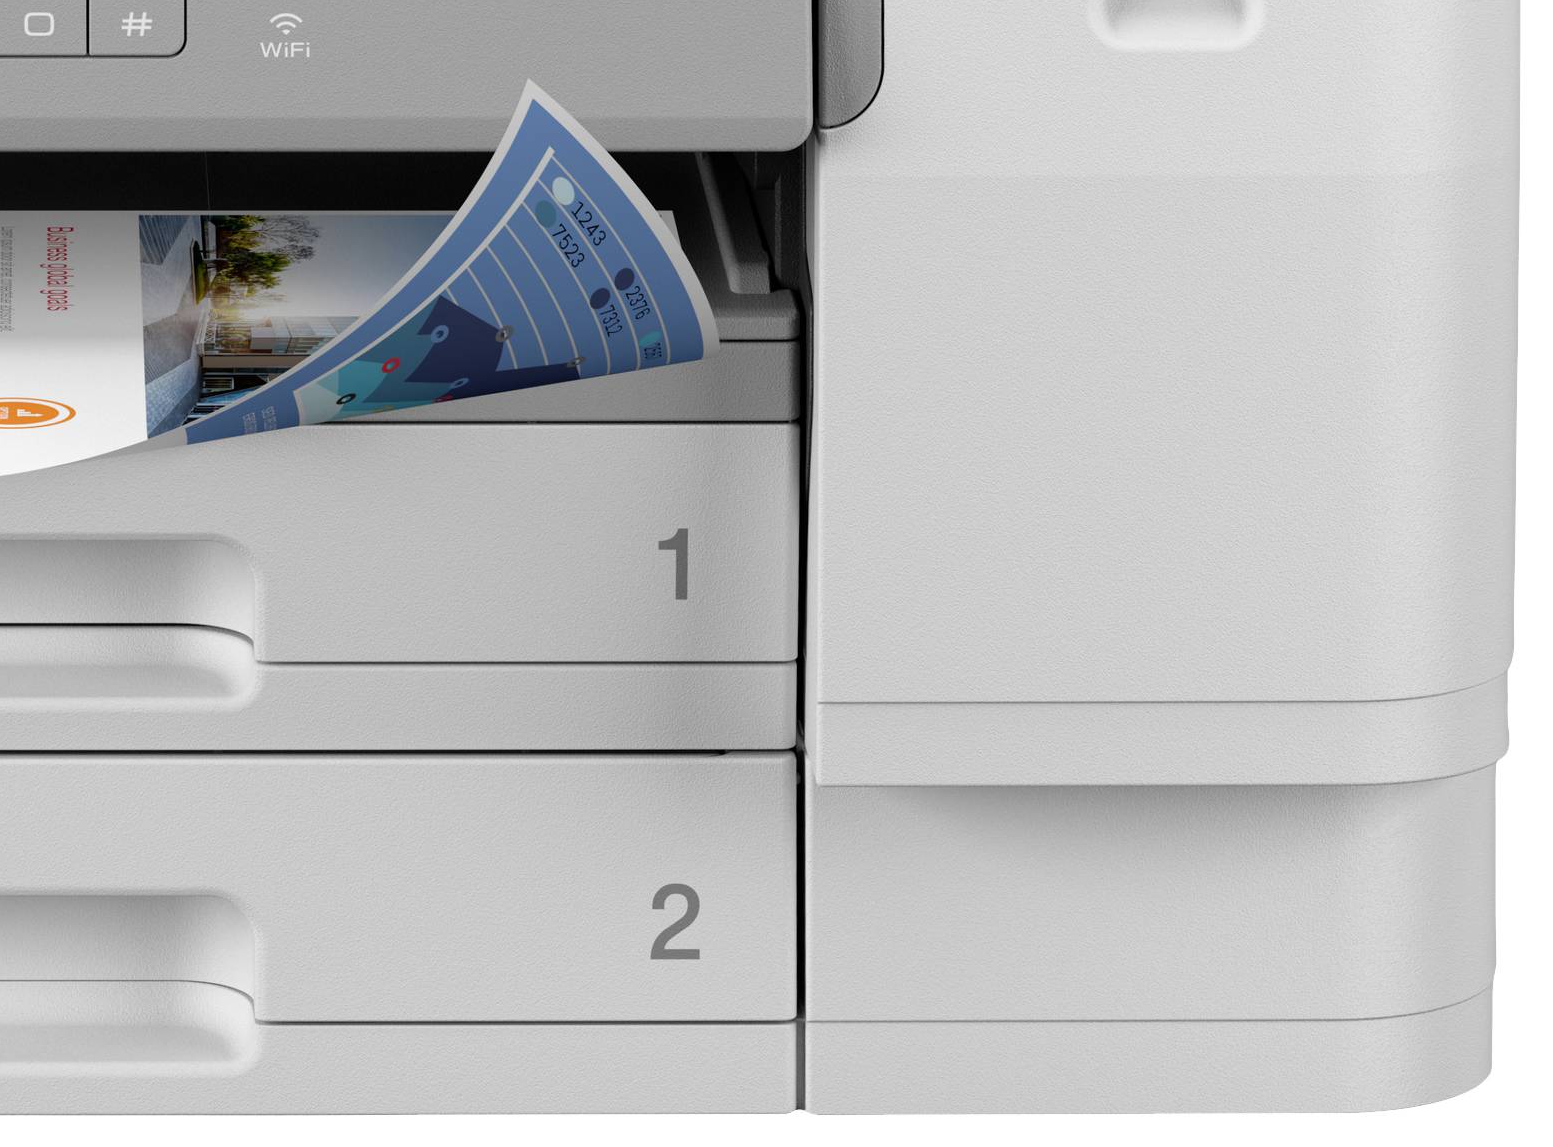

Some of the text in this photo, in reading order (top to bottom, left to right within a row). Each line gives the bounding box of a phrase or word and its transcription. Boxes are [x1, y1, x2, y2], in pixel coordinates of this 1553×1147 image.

[24, 12, 55, 37] 0
[121, 11, 153, 37] #
[259, 41, 311, 59] WiFi
[571, 201, 607, 246] 1243
[552, 223, 585, 268] 7523
[39, 226, 75, 312] Business global goals
[599, 304, 623, 337] 7312
[625, 285, 651, 320] 2376
[657, 528, 689, 601] 1
[650, 883, 701, 960] 2
